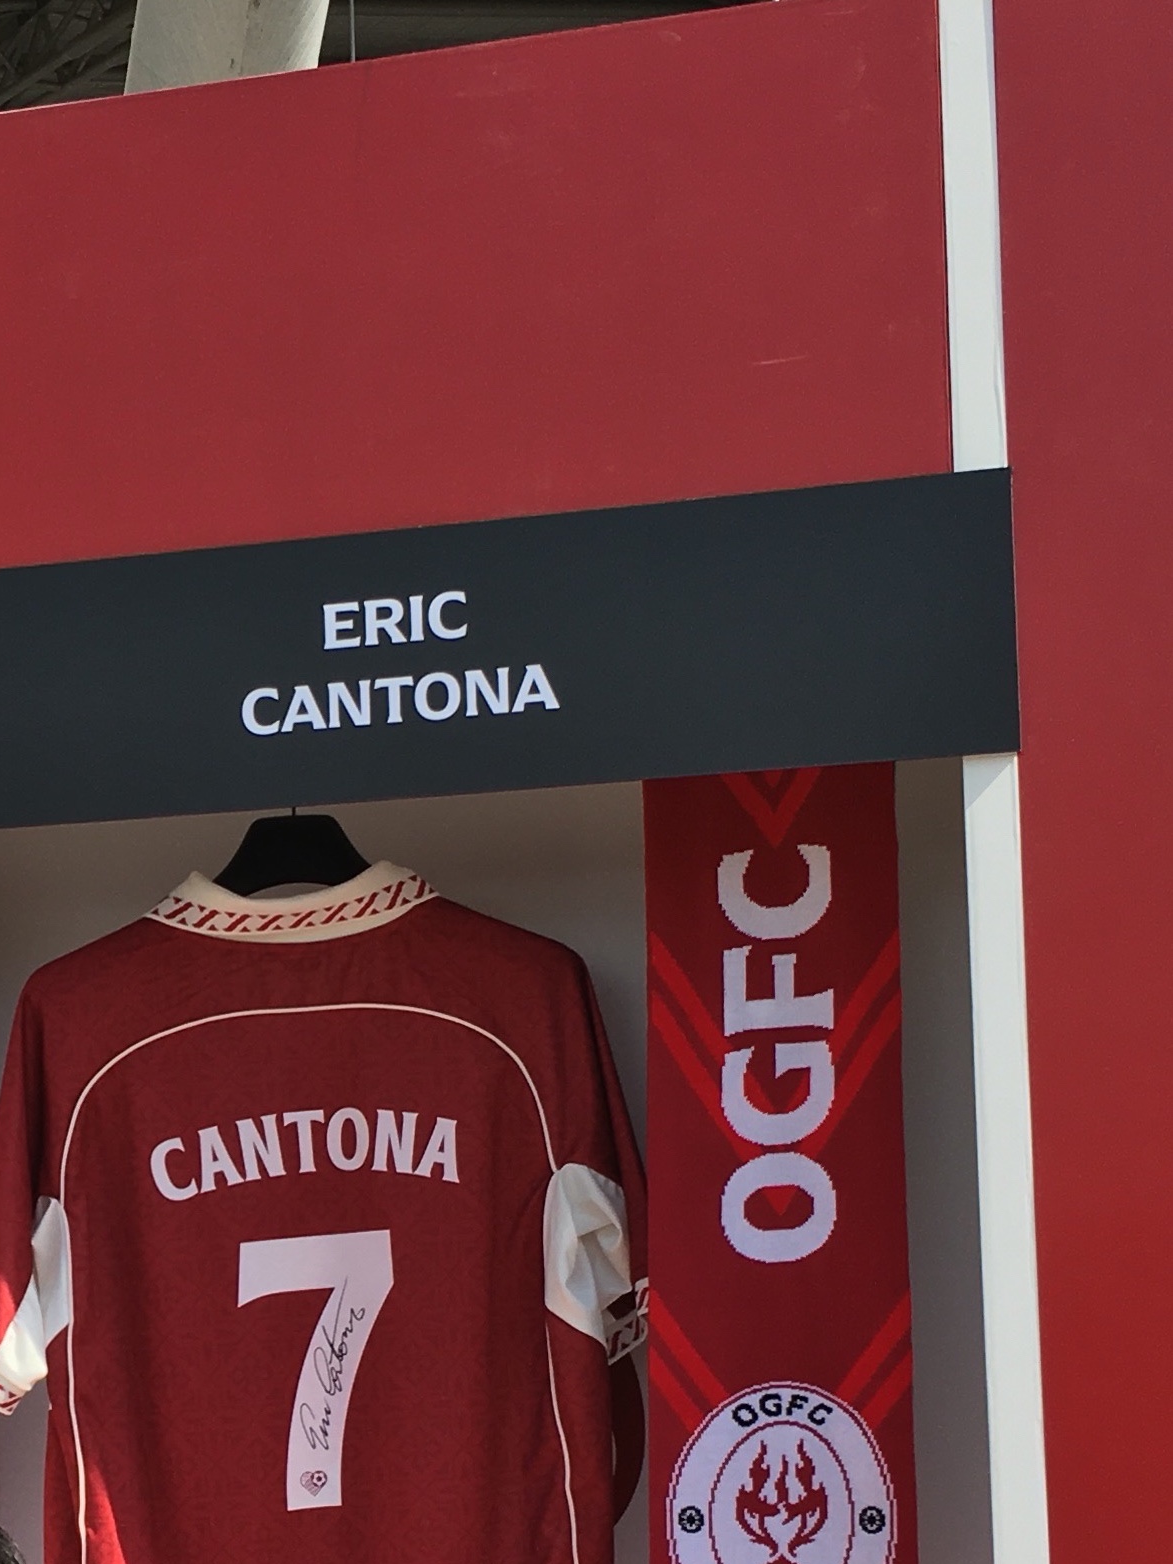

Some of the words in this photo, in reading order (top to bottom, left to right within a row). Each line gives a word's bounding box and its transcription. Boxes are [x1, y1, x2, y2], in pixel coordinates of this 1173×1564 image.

[322, 591, 467, 650] ERIC
[240, 664, 560, 735] CANTONA
[717, 843, 837, 1264] OGFC
[149, 1107, 460, 1201] CANTONA
[238, 1230, 395, 1512] 7
[732, 1393, 833, 1427] OGFC
